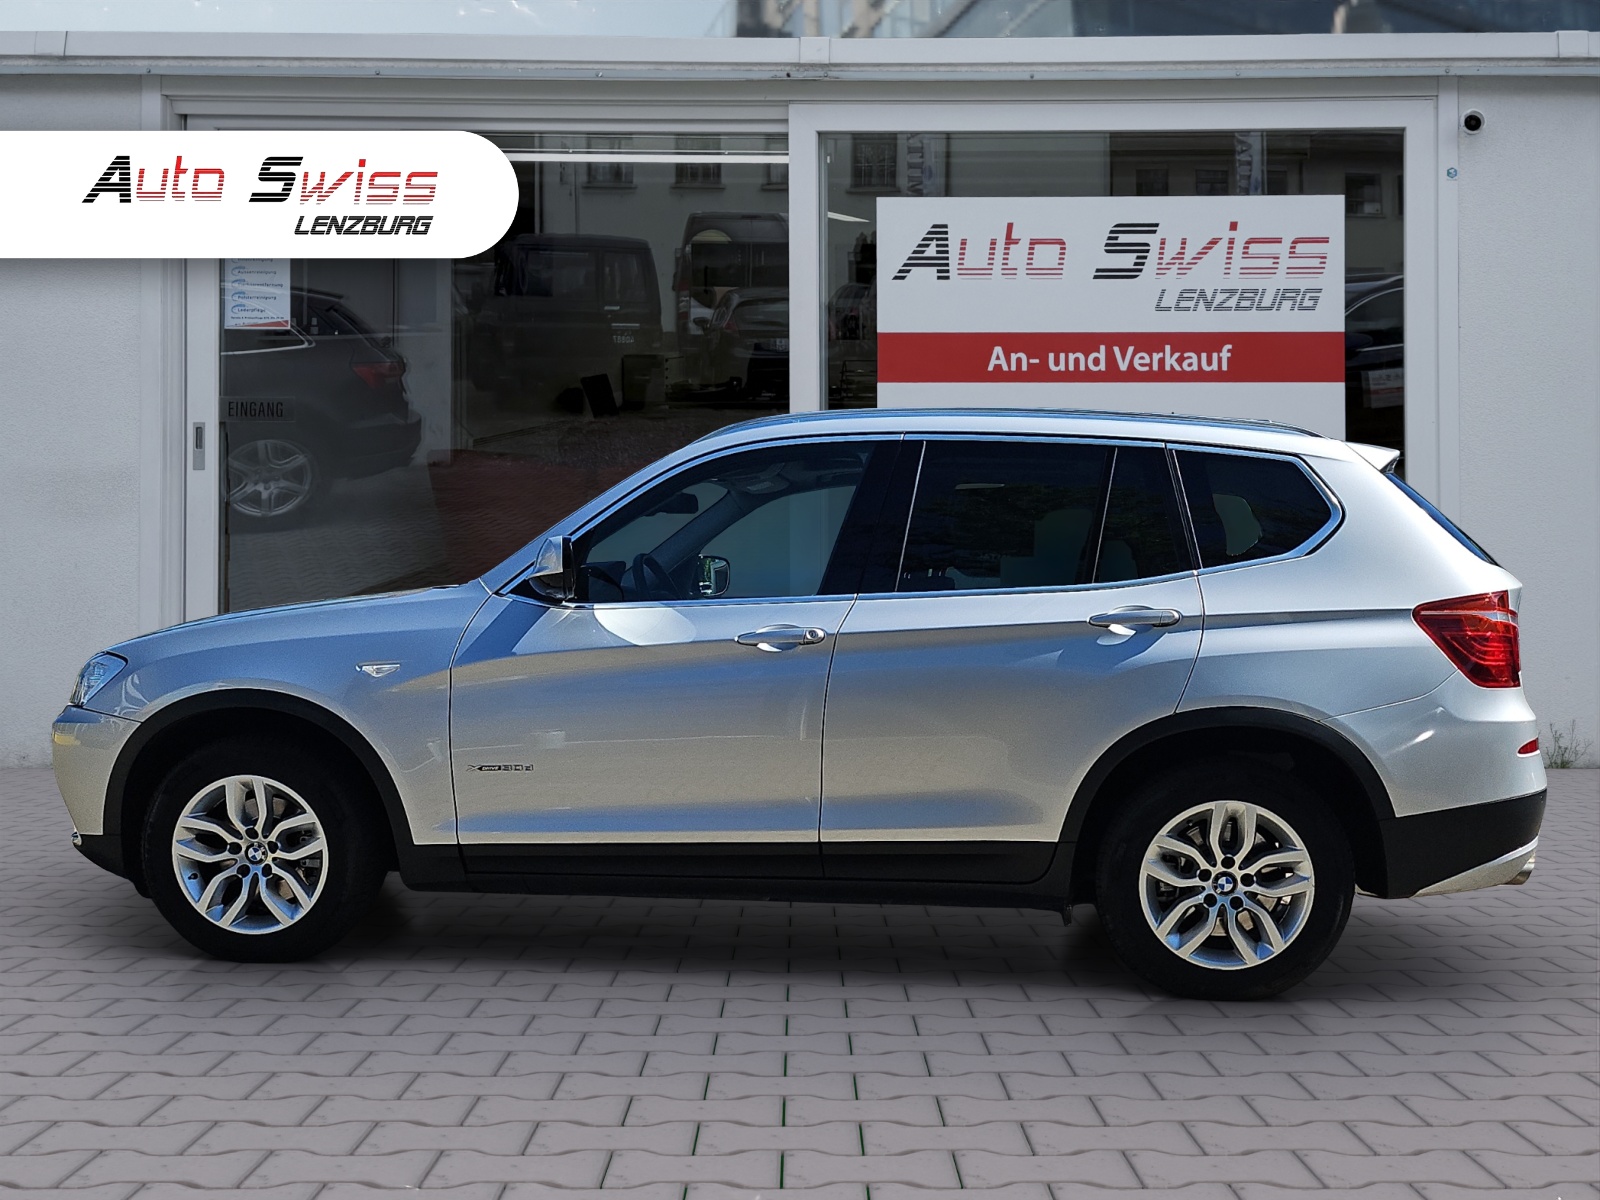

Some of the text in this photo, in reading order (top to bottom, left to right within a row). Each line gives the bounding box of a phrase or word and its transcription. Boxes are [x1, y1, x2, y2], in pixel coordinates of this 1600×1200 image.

[892, 221, 1330, 280] Auto Swiss
[1155, 288, 1323, 311] LENZBURG
[987, 345, 1232, 371] An- und Verkauf
[228, 401, 283, 417] EINGANG
